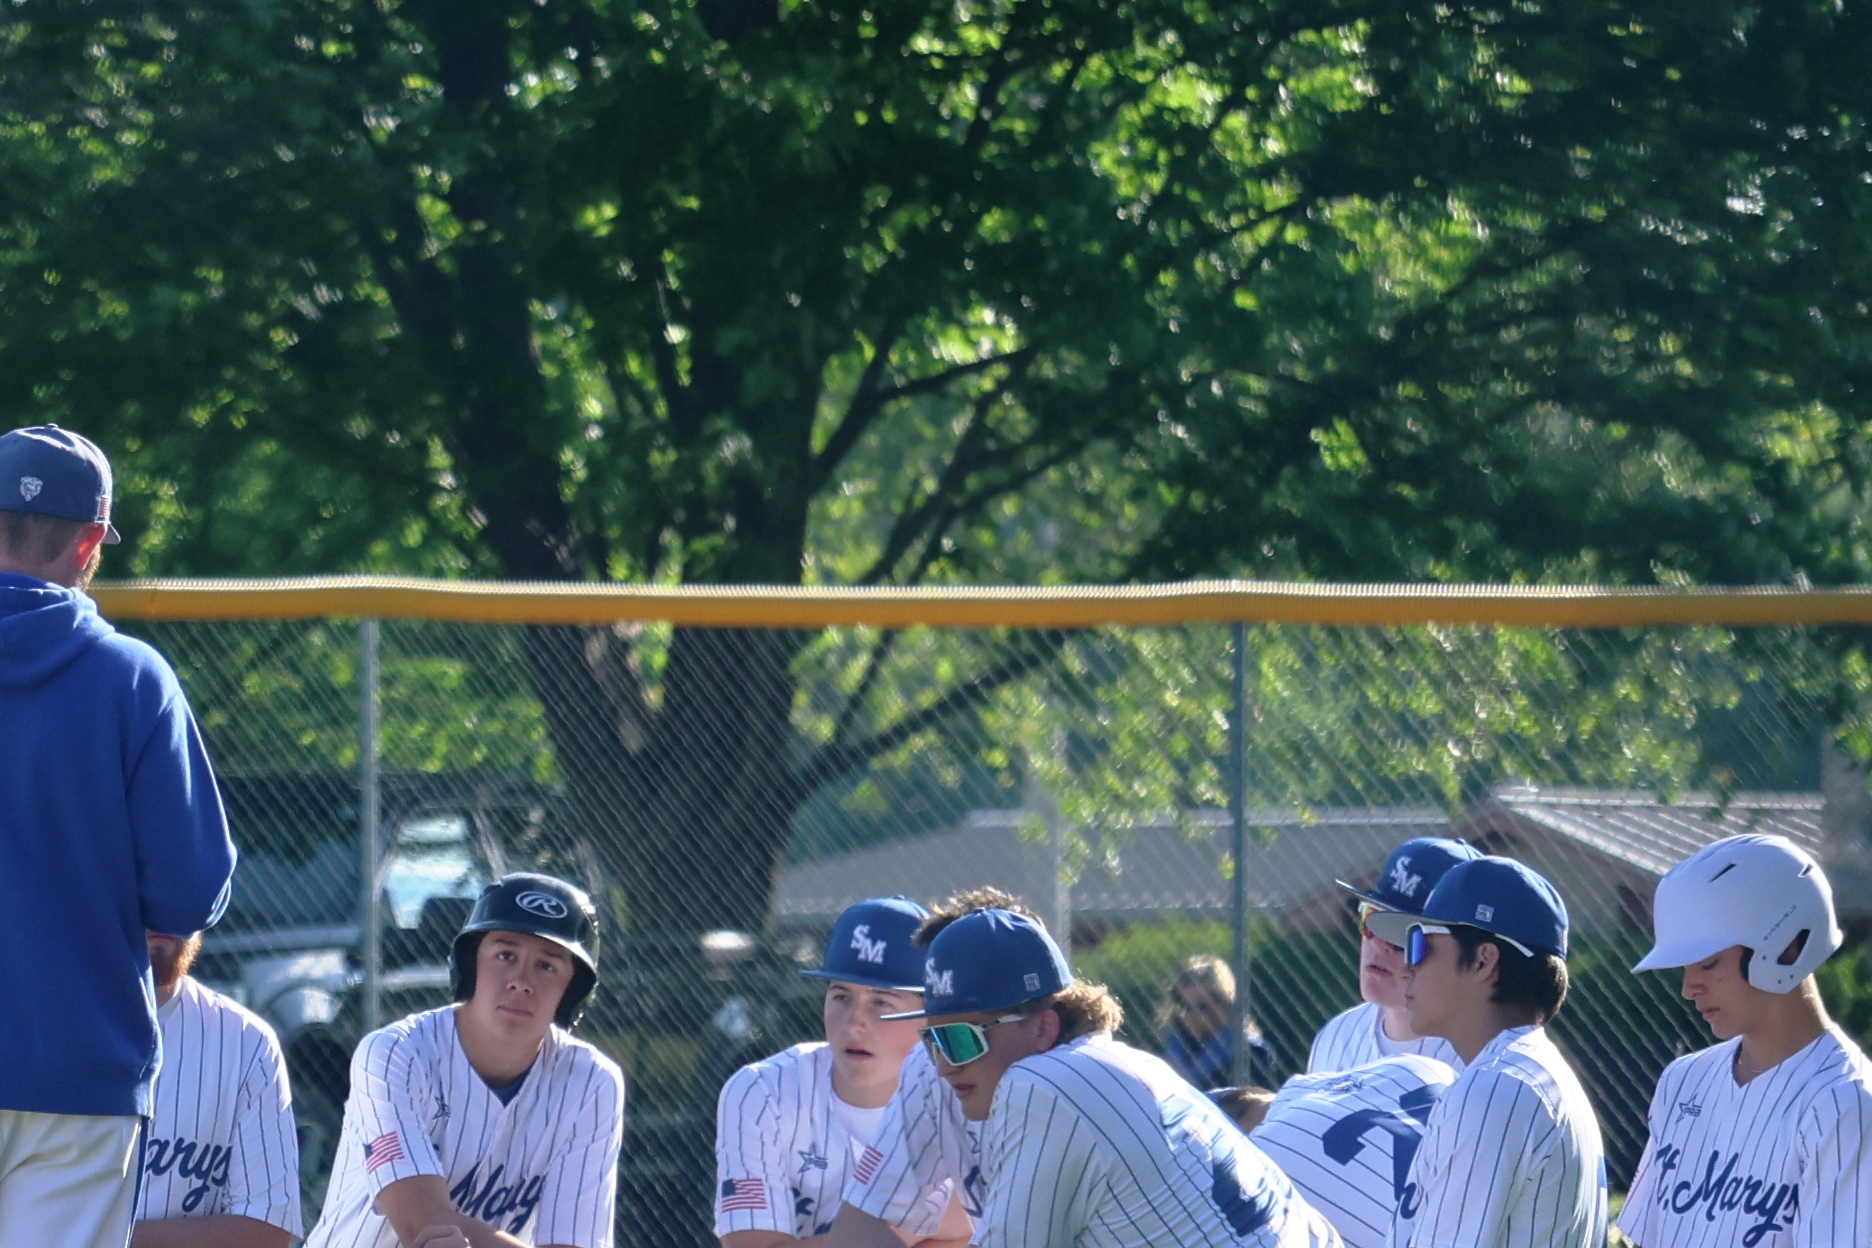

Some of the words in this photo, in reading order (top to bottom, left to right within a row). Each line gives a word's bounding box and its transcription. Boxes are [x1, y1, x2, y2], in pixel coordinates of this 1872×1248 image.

[850, 924, 887, 965] SM
[925, 957, 954, 997] SM
[145, 1137, 233, 1213] arys
